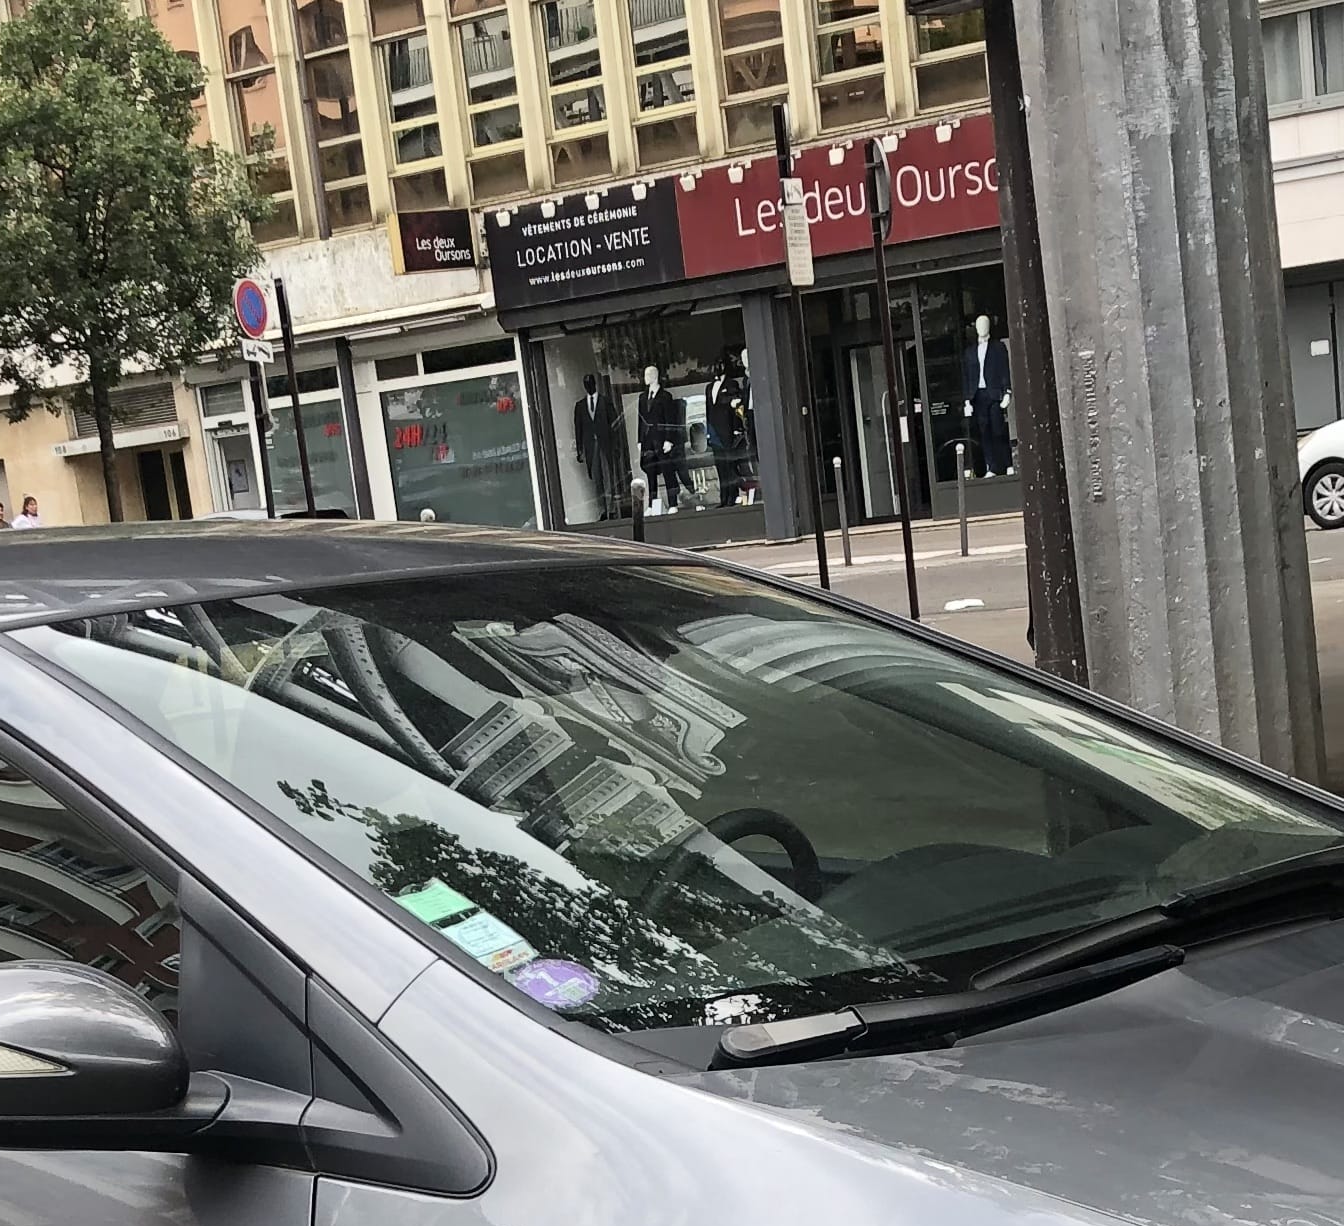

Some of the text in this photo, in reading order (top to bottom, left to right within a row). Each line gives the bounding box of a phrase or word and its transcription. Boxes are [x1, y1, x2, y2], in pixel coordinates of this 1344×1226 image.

[802, 180, 866, 225] deu
[896, 158, 999, 208] Ourso
[521, 205, 638, 238] VÊTEMENTS DE CÉRÉMONIE
[416, 235, 456, 250] Les deux
[434, 249, 472, 262] Oursons
[516, 237, 593, 268] LOCATION
[603, 226, 651, 252] VENTE
[528, 256, 646, 286] www.lesdeuxoursons.com
